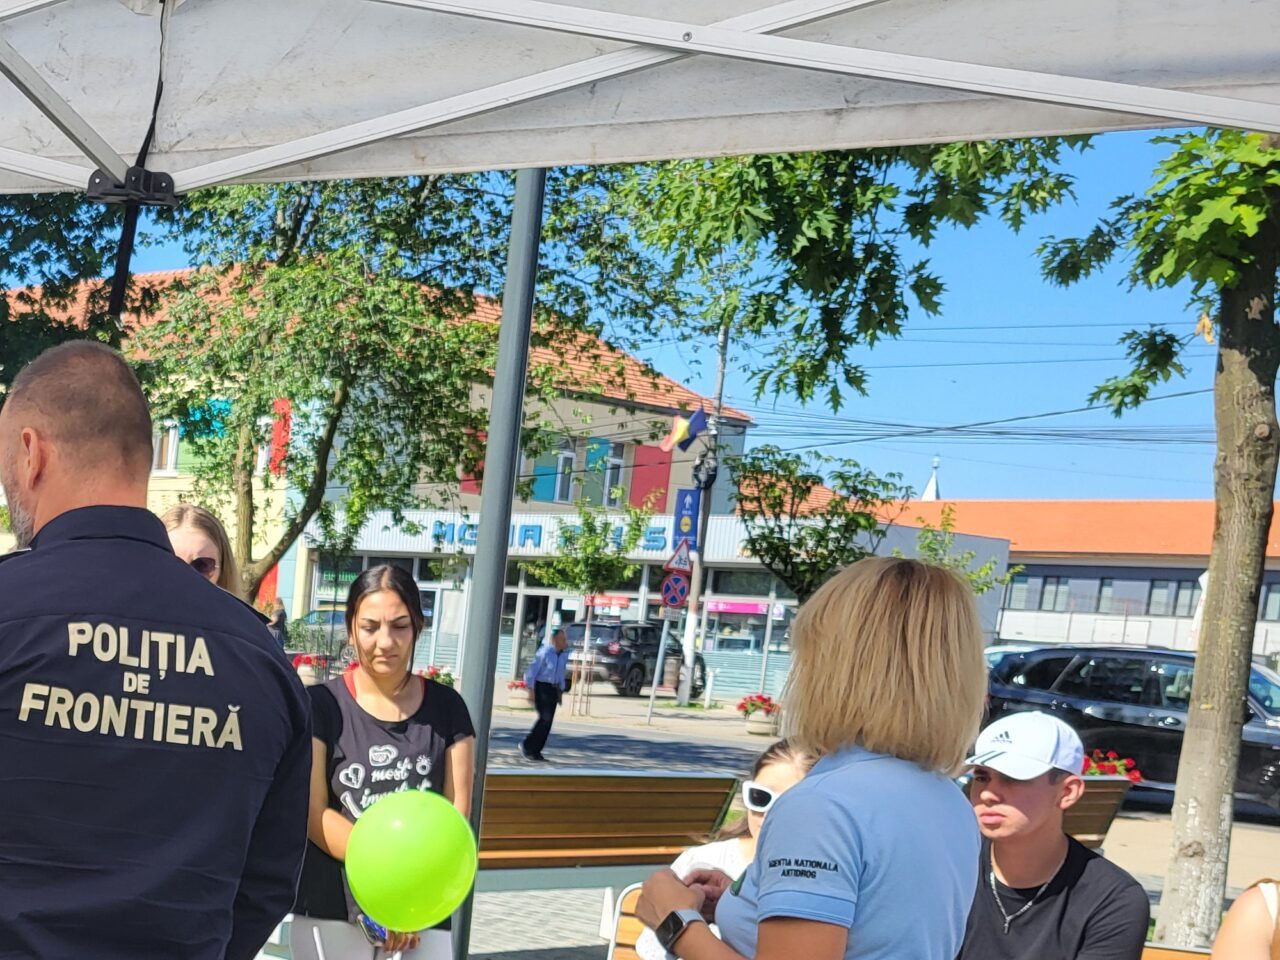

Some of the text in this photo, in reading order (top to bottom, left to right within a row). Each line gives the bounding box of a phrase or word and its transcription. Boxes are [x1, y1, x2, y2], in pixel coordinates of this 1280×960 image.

[67, 621, 215, 679] POLIȚIA
[122, 671, 150, 695] DE
[18, 683, 243, 751] FRONTIERĂ
